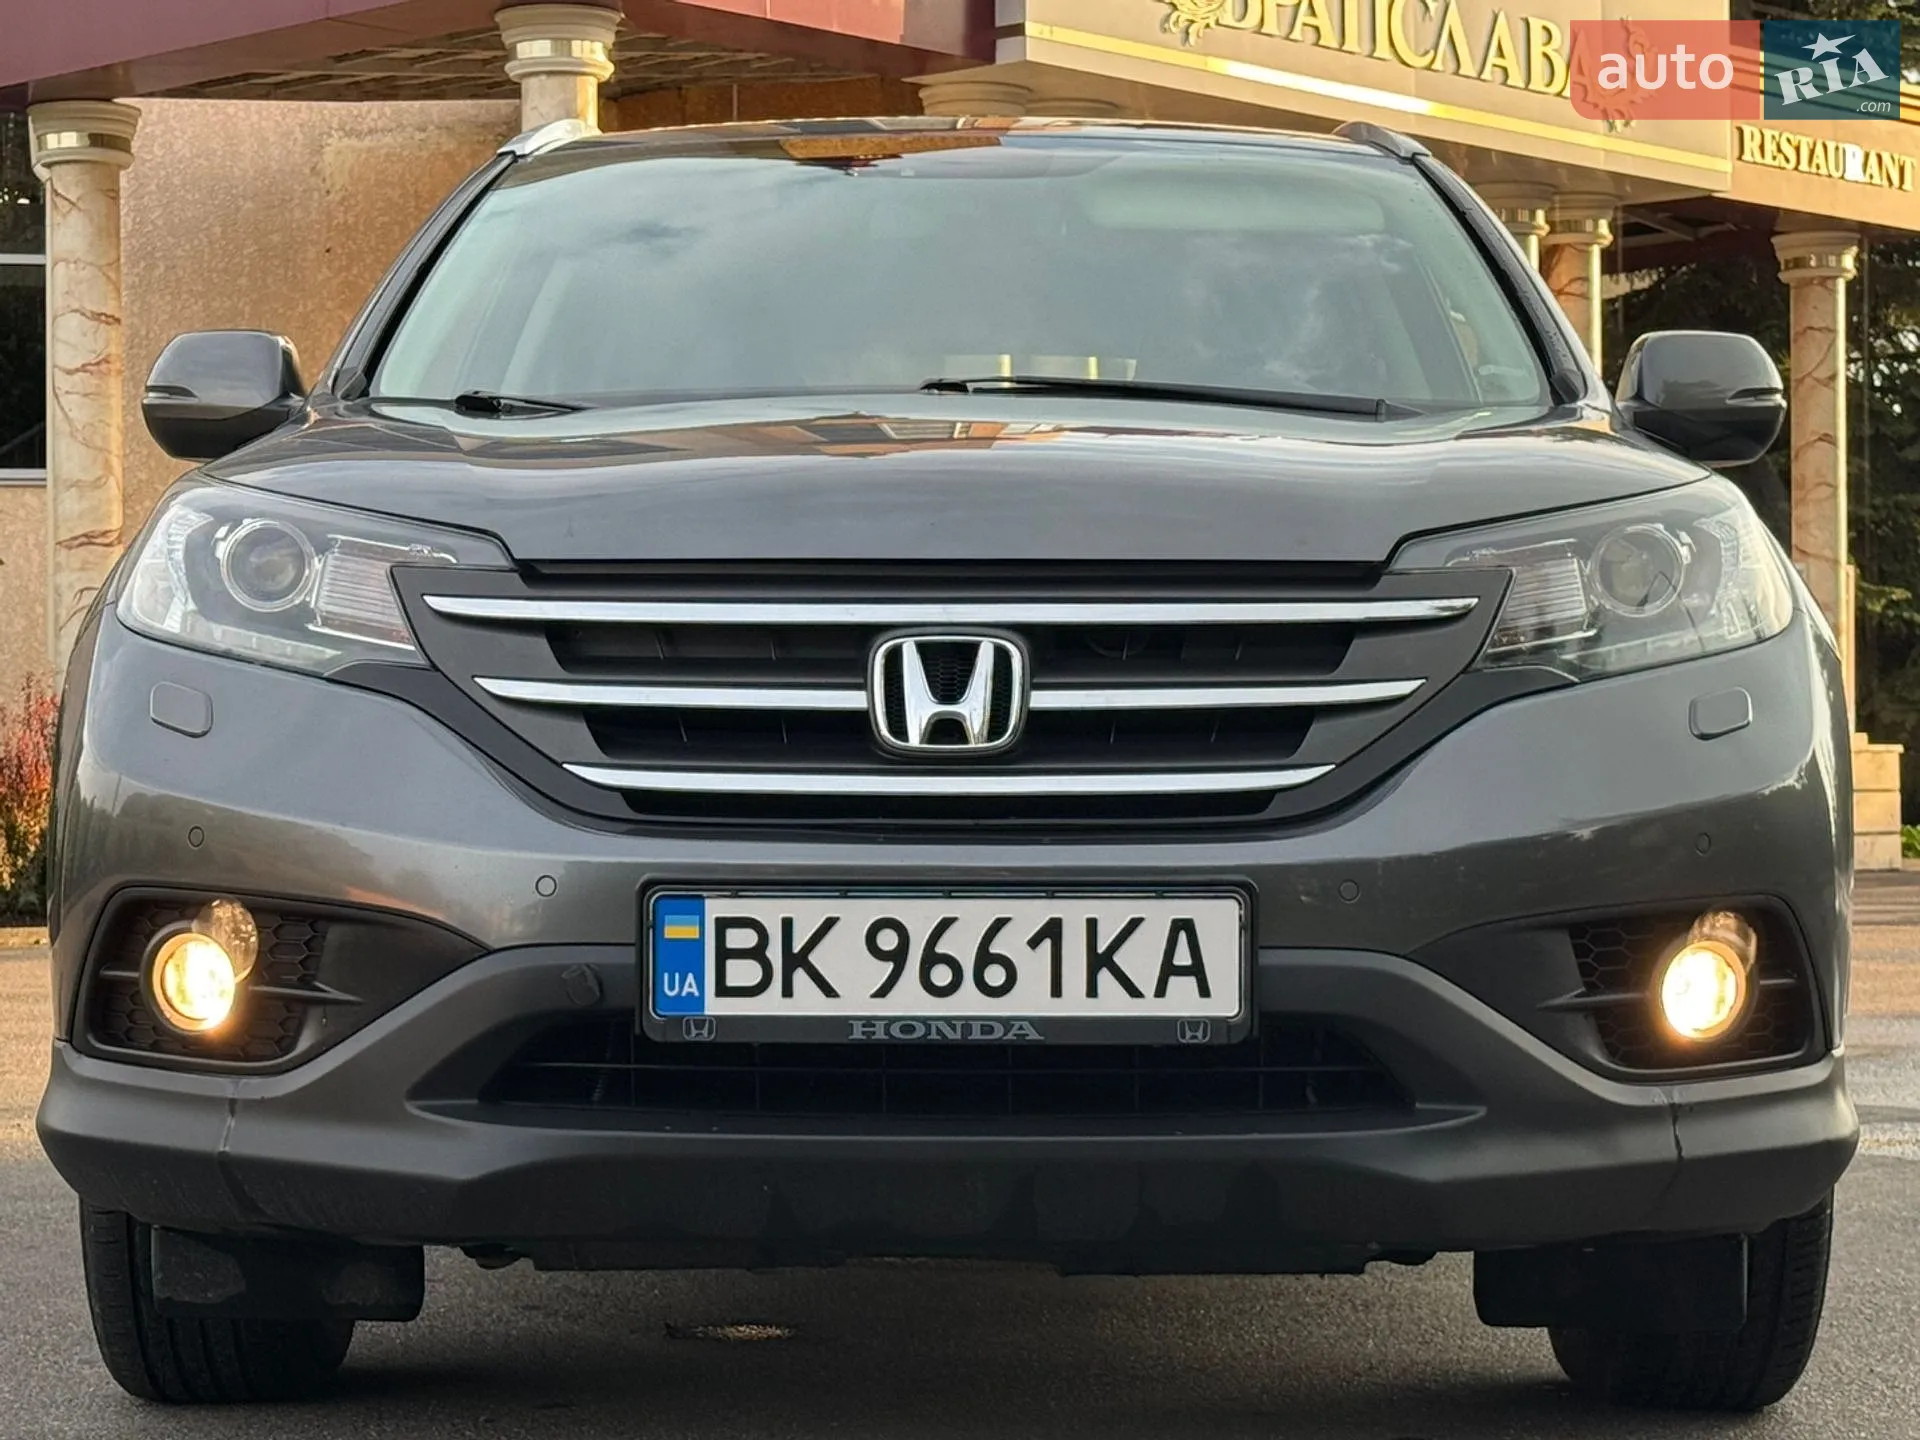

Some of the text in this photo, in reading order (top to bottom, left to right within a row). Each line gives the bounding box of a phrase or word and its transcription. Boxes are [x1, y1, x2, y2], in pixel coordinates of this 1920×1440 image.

[1738, 123, 1917, 192] RESTAURANT
[714, 916, 841, 998] BK
[663, 972, 699, 997] UA
[848, 1020, 1045, 1040] HONDA
